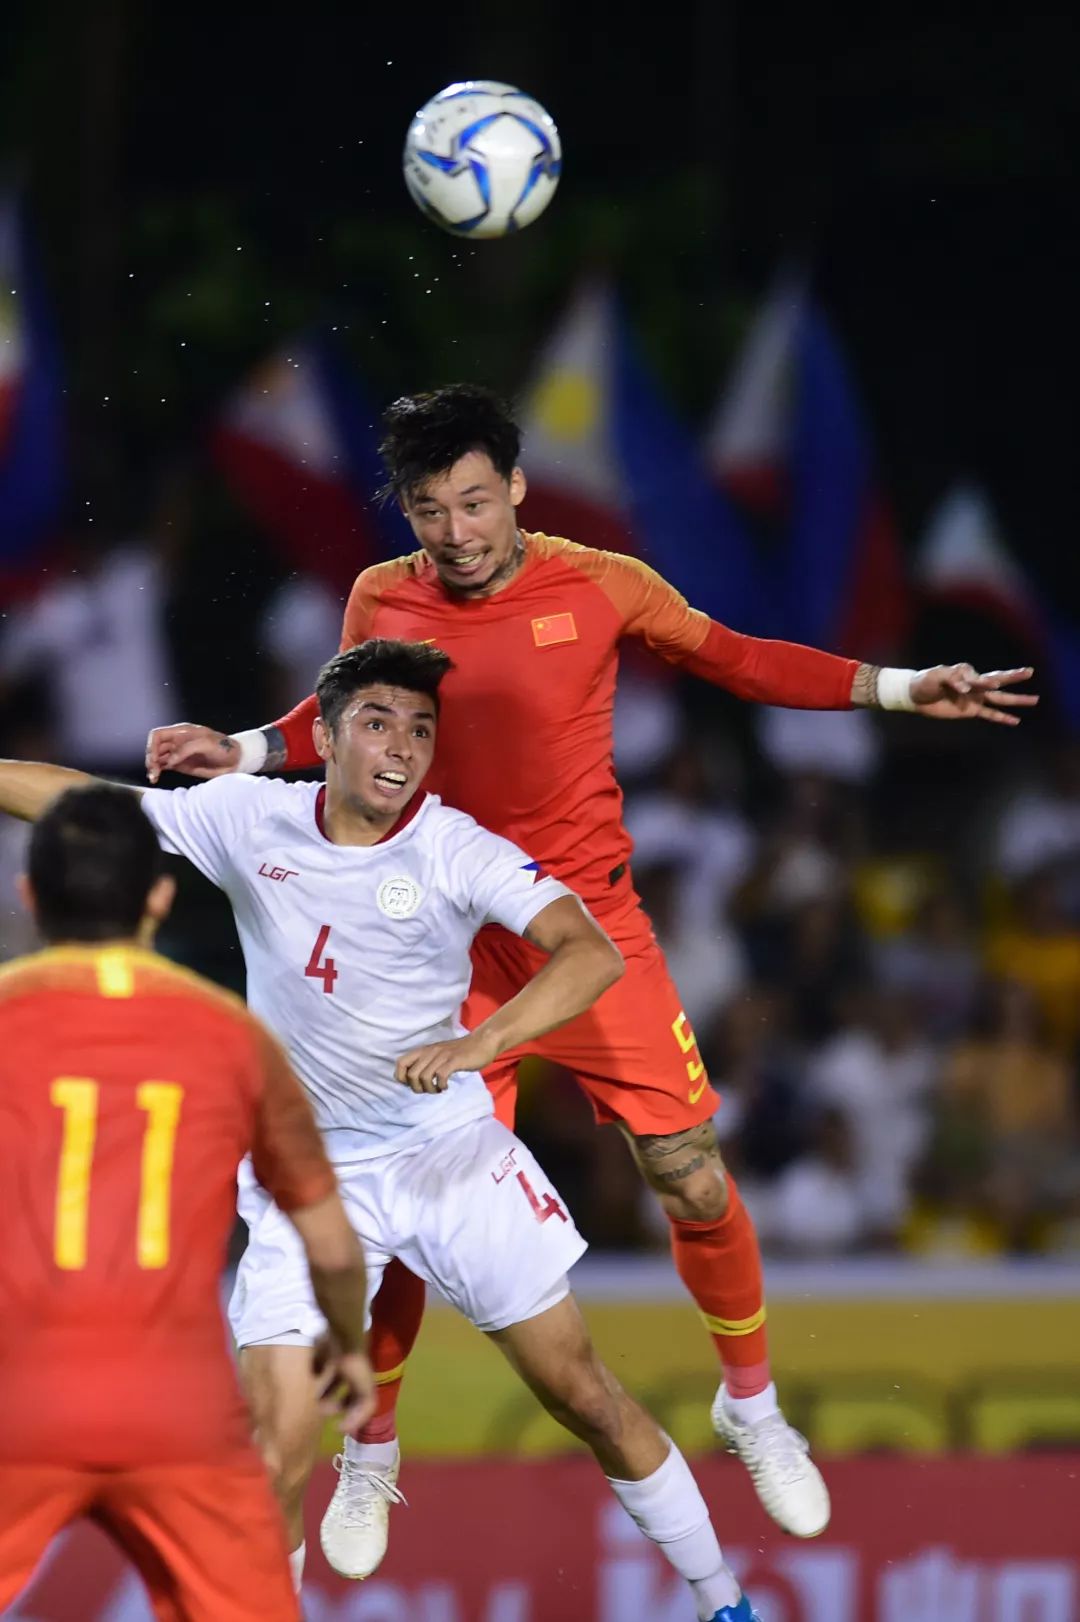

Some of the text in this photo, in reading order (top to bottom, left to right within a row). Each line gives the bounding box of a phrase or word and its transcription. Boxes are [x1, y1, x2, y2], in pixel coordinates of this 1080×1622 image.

[305, 924, 338, 994] 4
[671, 1010, 705, 1082] 5
[51, 1076, 184, 1270] 11
[516, 1170, 568, 1224] 4
